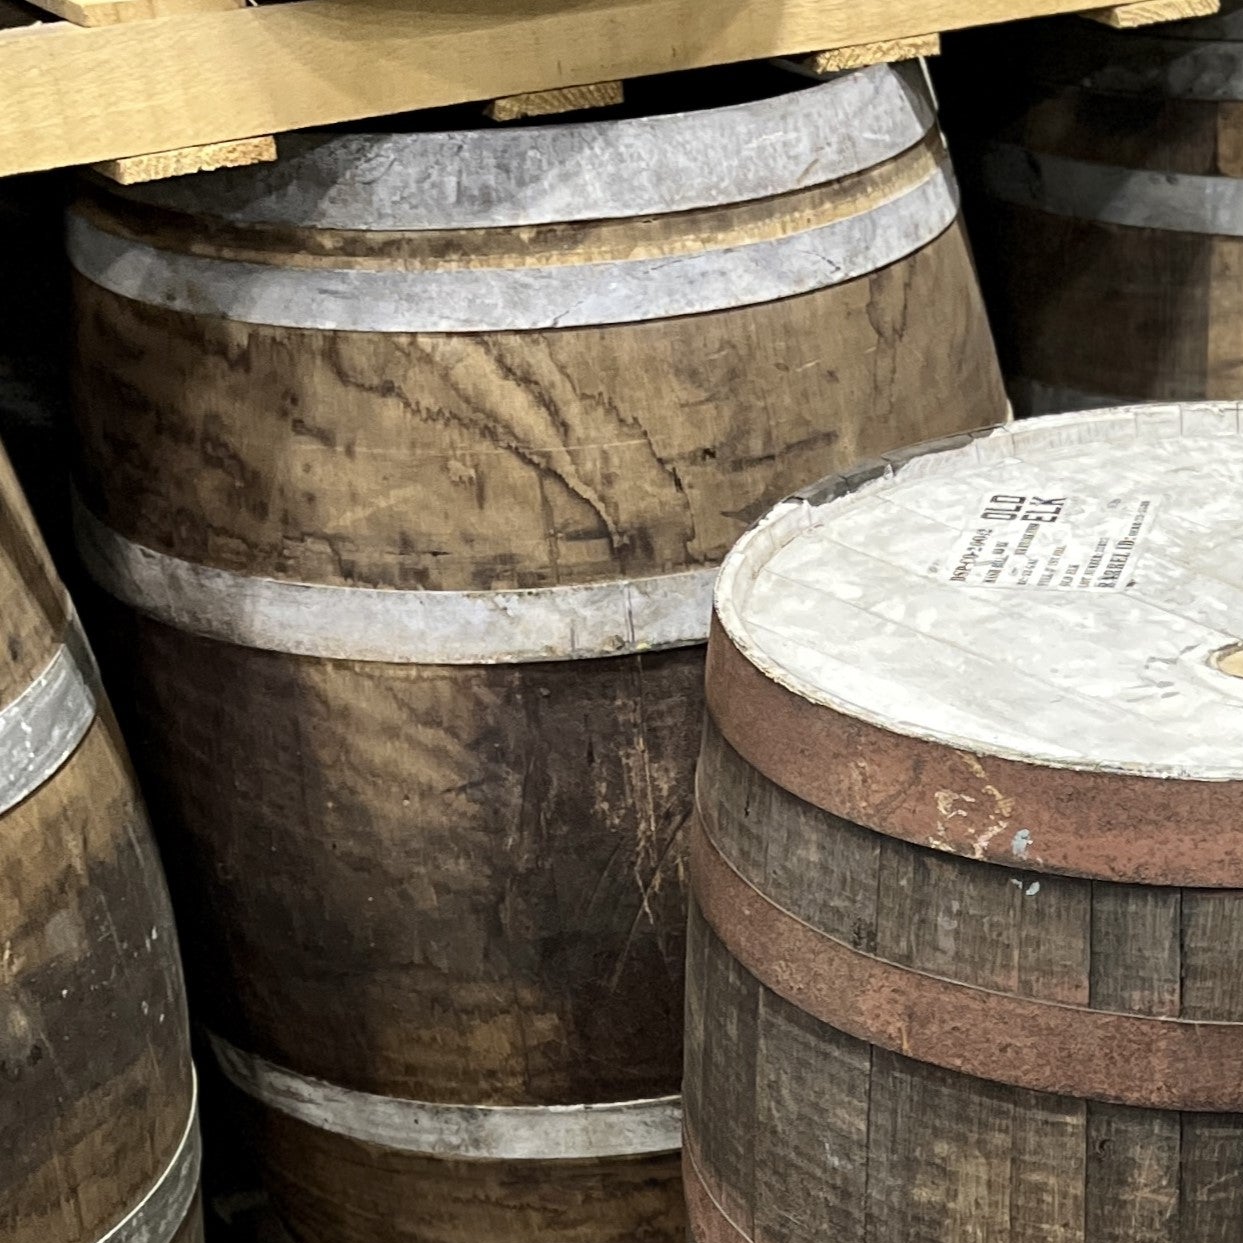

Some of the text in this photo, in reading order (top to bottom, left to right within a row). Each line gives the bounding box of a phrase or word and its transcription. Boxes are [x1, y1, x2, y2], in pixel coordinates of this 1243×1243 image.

[980, 494, 1027, 520] OLD
[1020, 496, 1067, 522] ELK
[1096, 552, 1130, 588] BARREL
